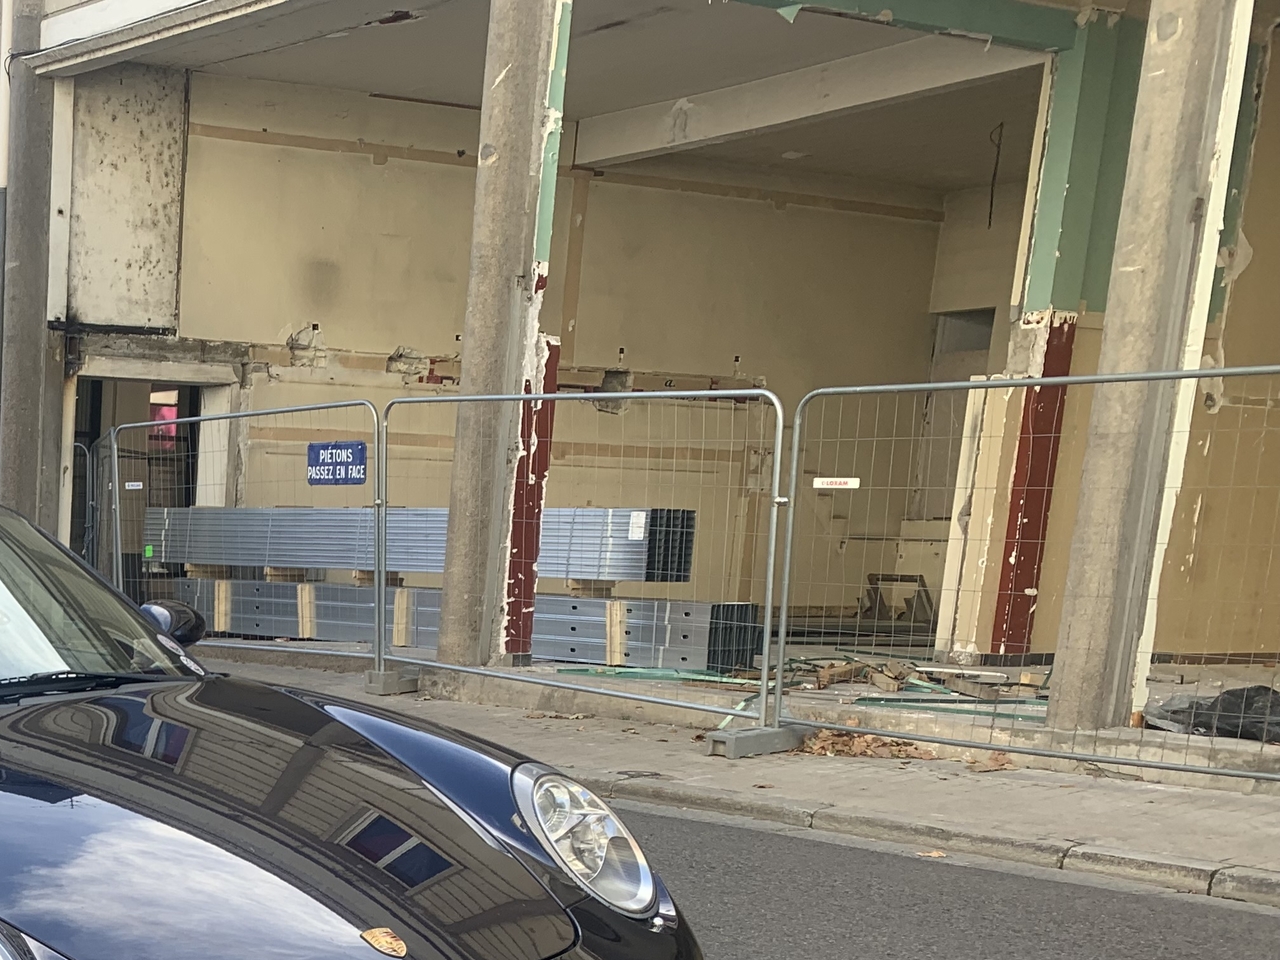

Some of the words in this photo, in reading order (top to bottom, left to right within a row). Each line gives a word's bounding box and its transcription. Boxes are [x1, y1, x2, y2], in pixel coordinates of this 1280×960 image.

[320, 446, 353, 463] PIÉTONS
[308, 465, 334, 479] PASSEZ
[336, 465, 346, 479] EN
[348, 465, 365, 479] FACE
